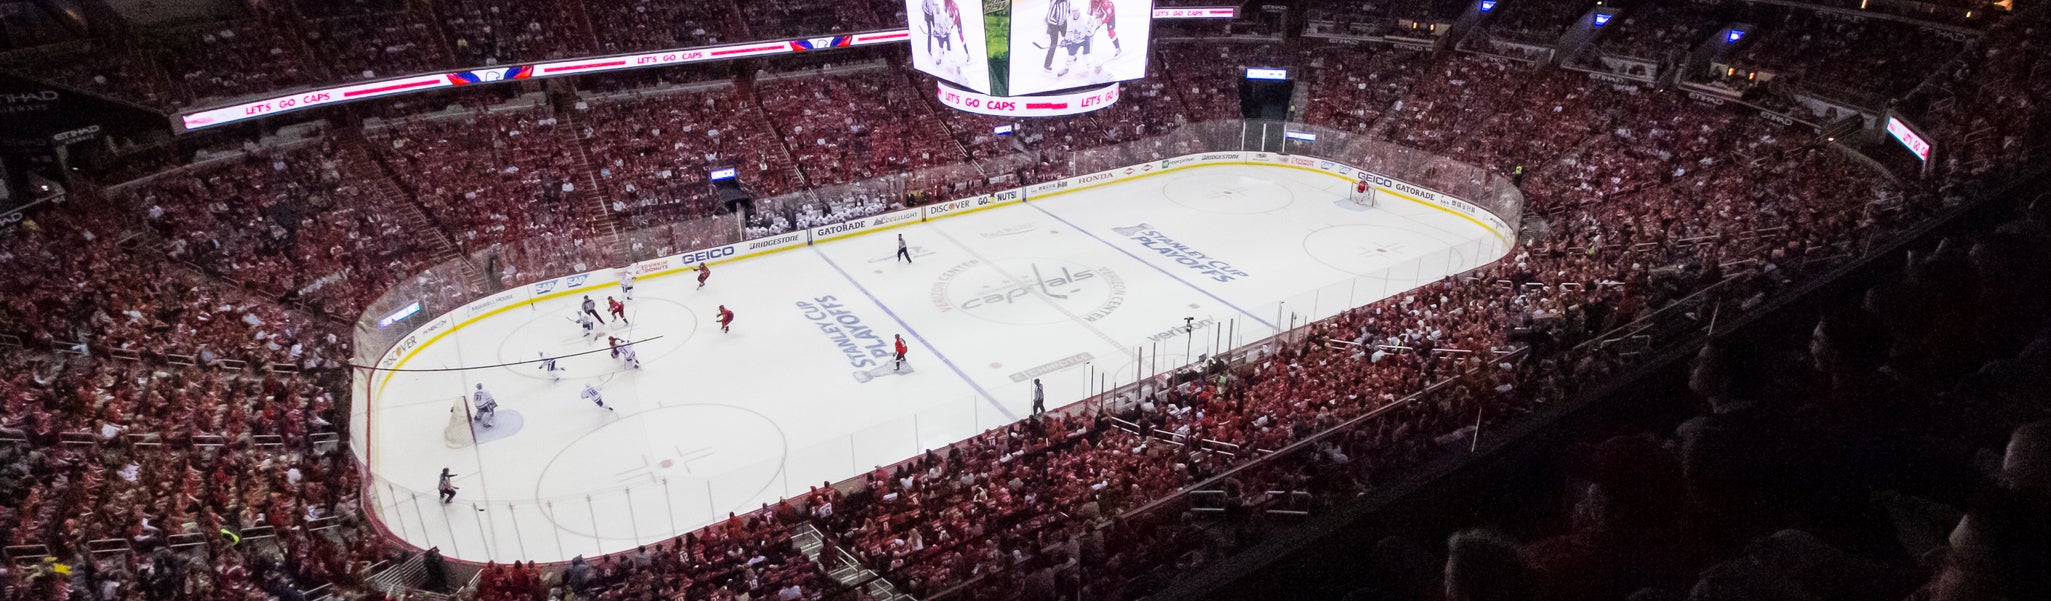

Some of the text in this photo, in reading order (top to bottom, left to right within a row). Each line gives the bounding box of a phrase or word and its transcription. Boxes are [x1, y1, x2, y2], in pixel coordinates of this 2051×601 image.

[637, 52, 703, 64] LET'S GO CAPS
[246, 93, 330, 115] LET'S GO CAPS
[945, 91, 1016, 111] LET'S GO CAPS
[1081, 95, 1101, 107] LET'S
[1105, 91, 1114, 102] GO
[1078, 172, 1114, 184] HONDA
[1357, 171, 1392, 188] GEICO
[1395, 183, 1435, 201] GATORADE
[930, 200, 970, 215] DISCOVER
[817, 220, 866, 236] GATORADE
[749, 234, 799, 250] BRIDGESTONE
[682, 246, 735, 265] GEICO
[1130, 235, 1236, 283] PLAYOFFS
[1141, 230, 1249, 277] STANLEY CUP
[536, 281, 557, 294] SAP
[567, 274, 587, 288] SAP
[795, 300, 877, 368] STANLEY CUP
[814, 294, 889, 359] PLAYOFFS
